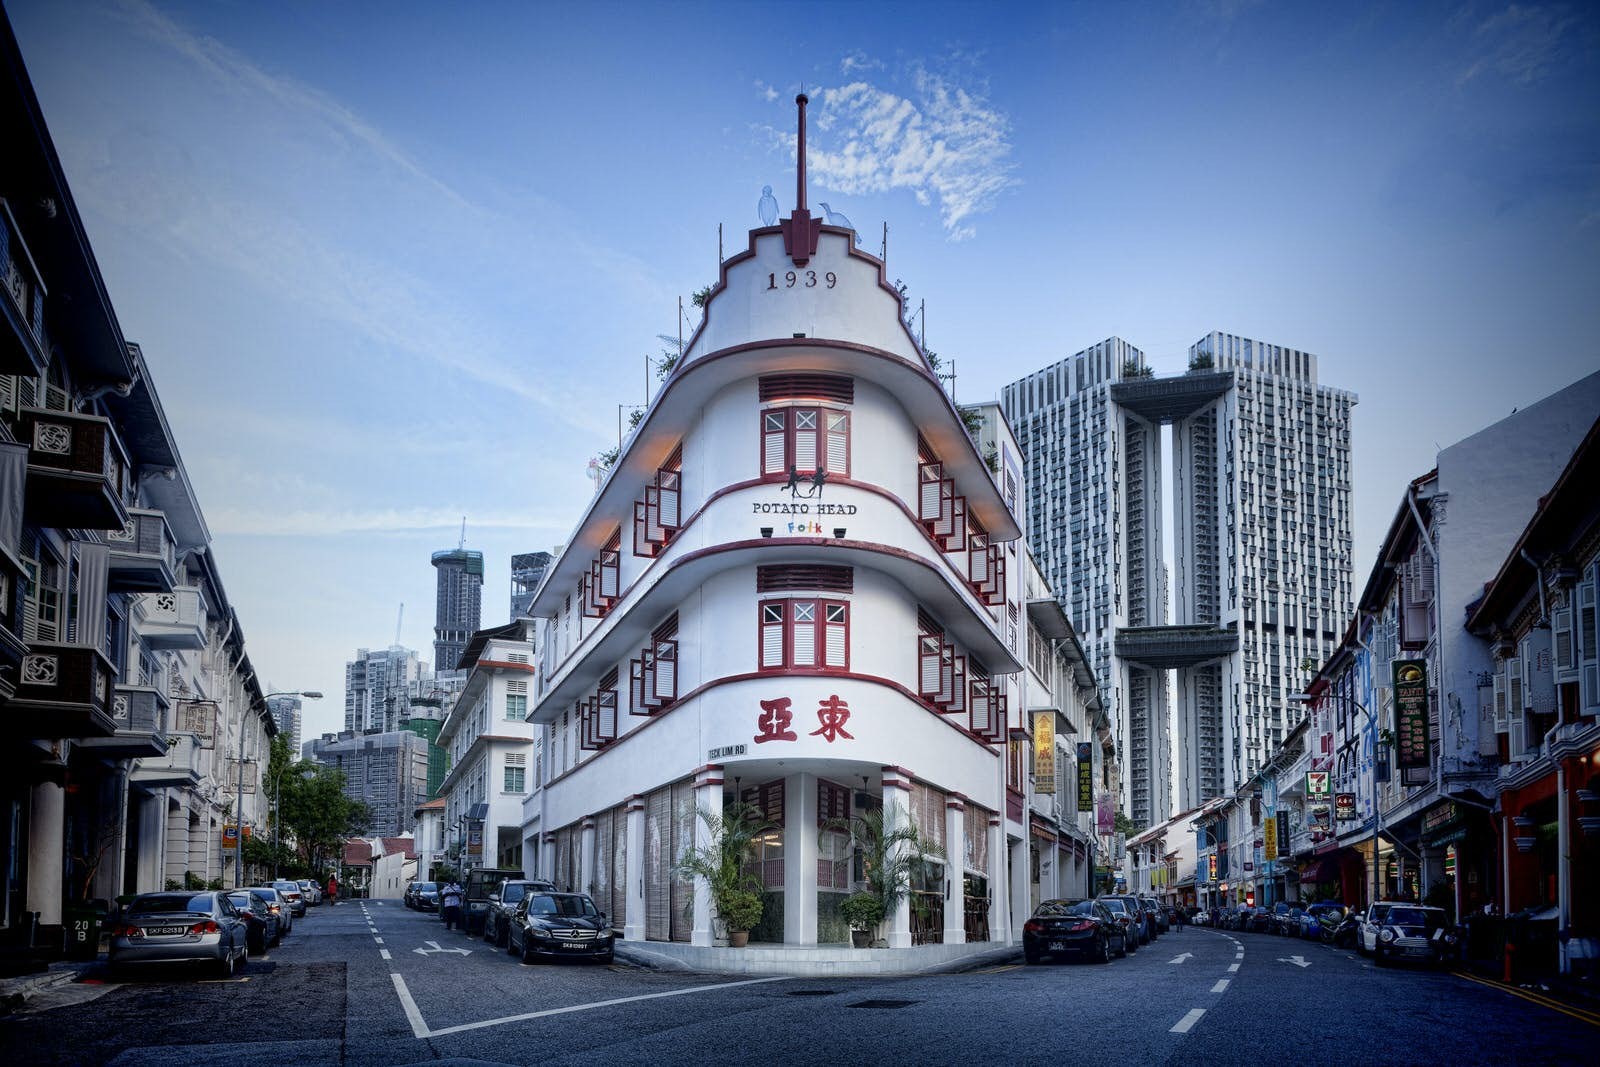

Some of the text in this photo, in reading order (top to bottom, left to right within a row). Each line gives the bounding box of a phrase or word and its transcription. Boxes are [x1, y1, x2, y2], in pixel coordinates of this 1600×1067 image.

[767, 270, 837, 291] 1939
[752, 503, 857, 515] POTATO HEAD
[787, 520, 822, 534] Folk
[709, 745, 745, 759] TECK LIM RD
[74, 920, 89, 931] 20
[77, 931, 87, 942] B
